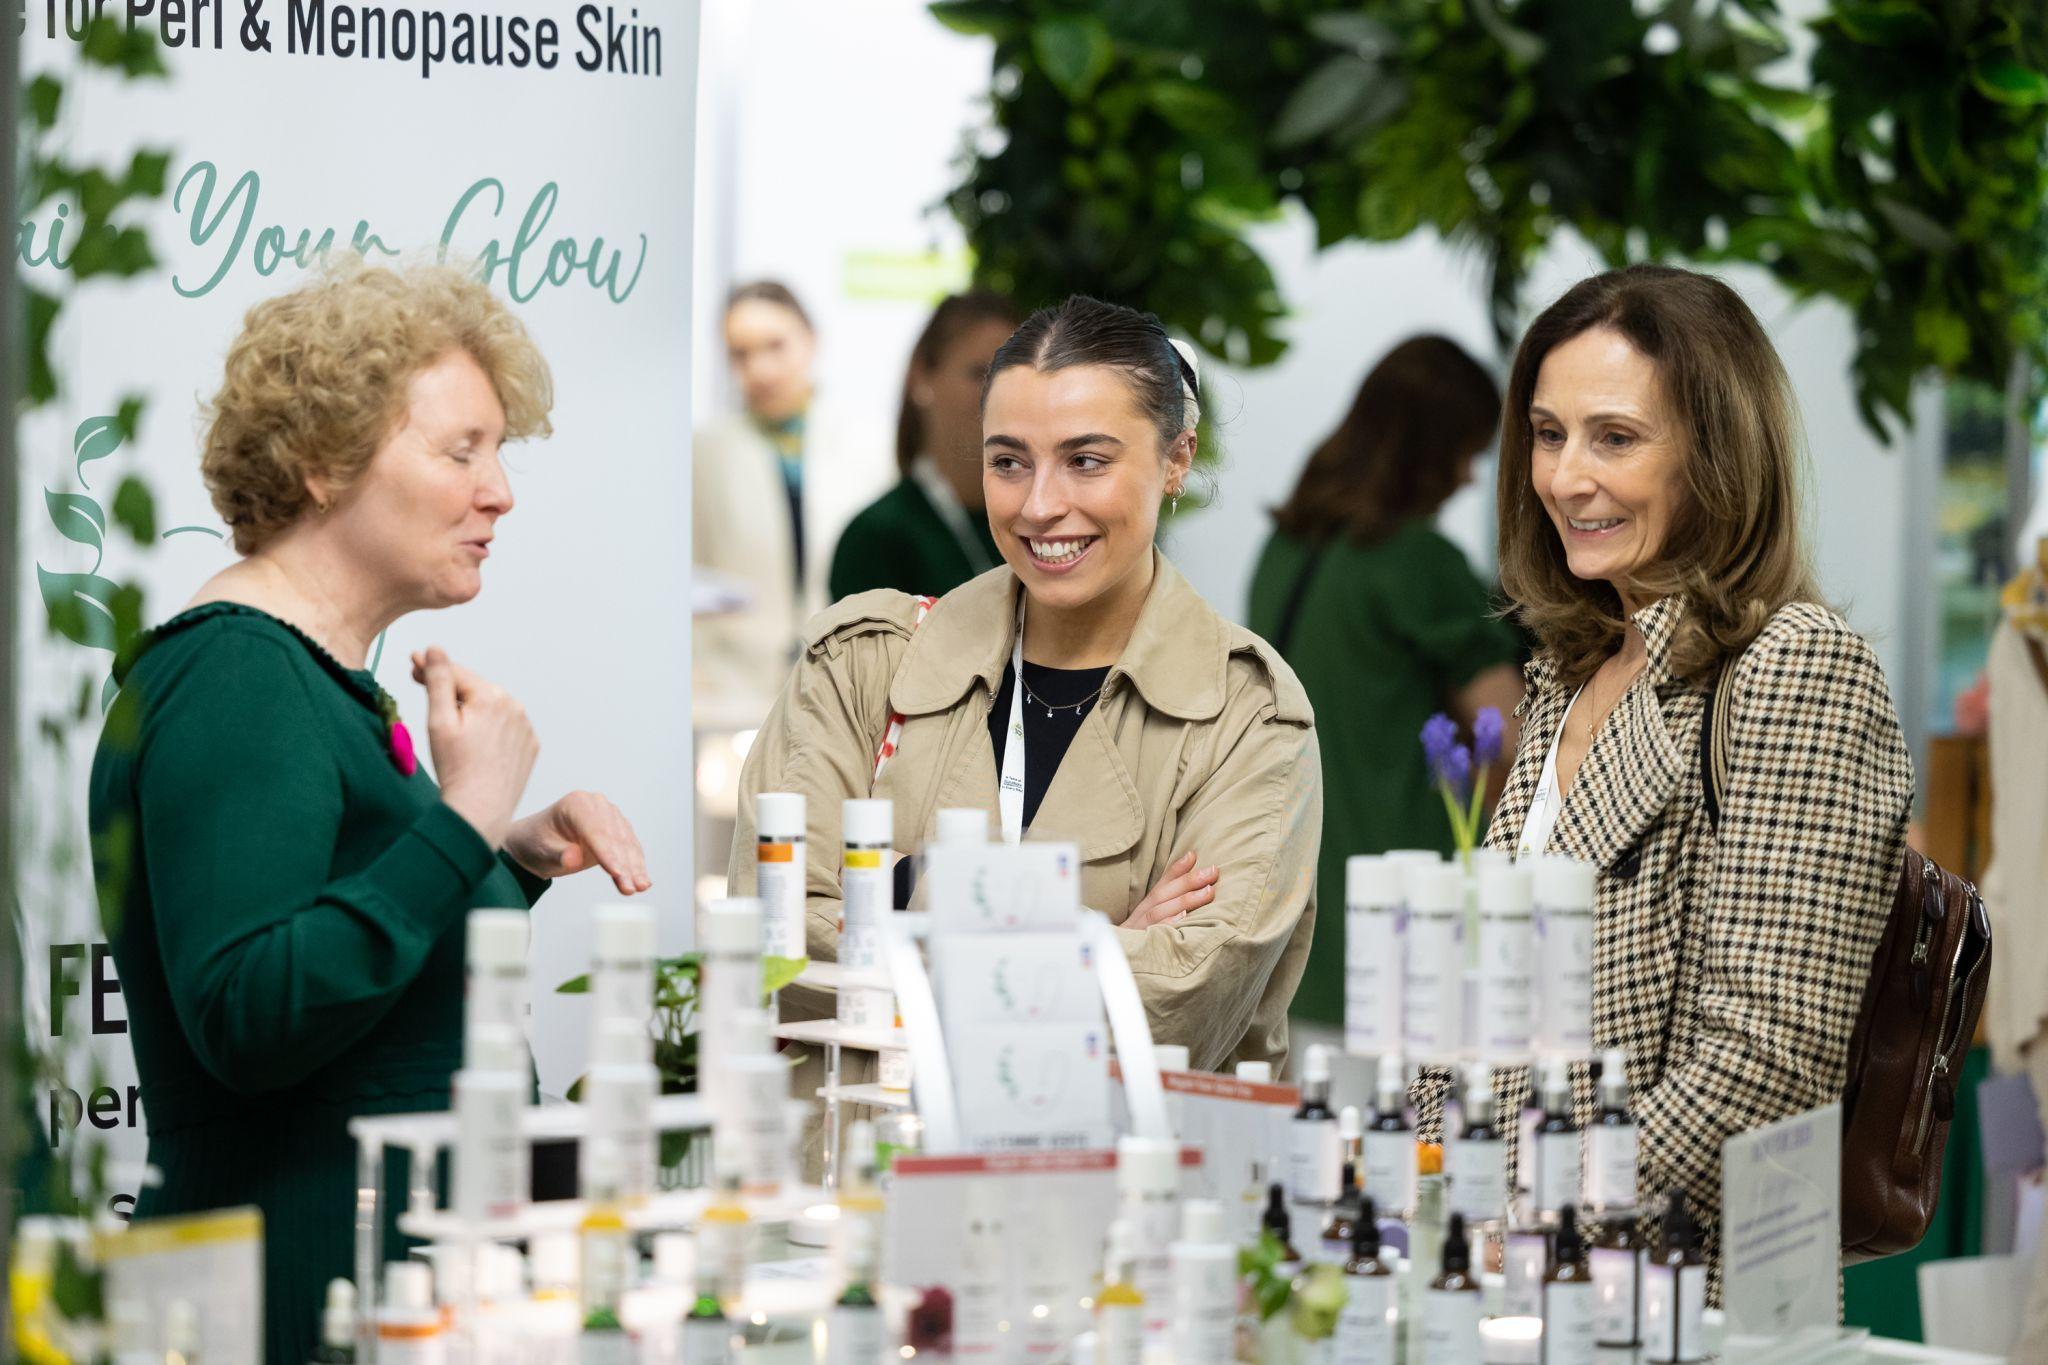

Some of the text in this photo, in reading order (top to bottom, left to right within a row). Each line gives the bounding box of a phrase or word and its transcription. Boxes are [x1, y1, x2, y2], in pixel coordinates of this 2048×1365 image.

[239, 0, 272, 53] &
[287, 0, 559, 79] Menopause
[575, 3, 662, 76] Skin
[172, 160, 401, 298] Your
[436, 177, 647, 304] Glow
